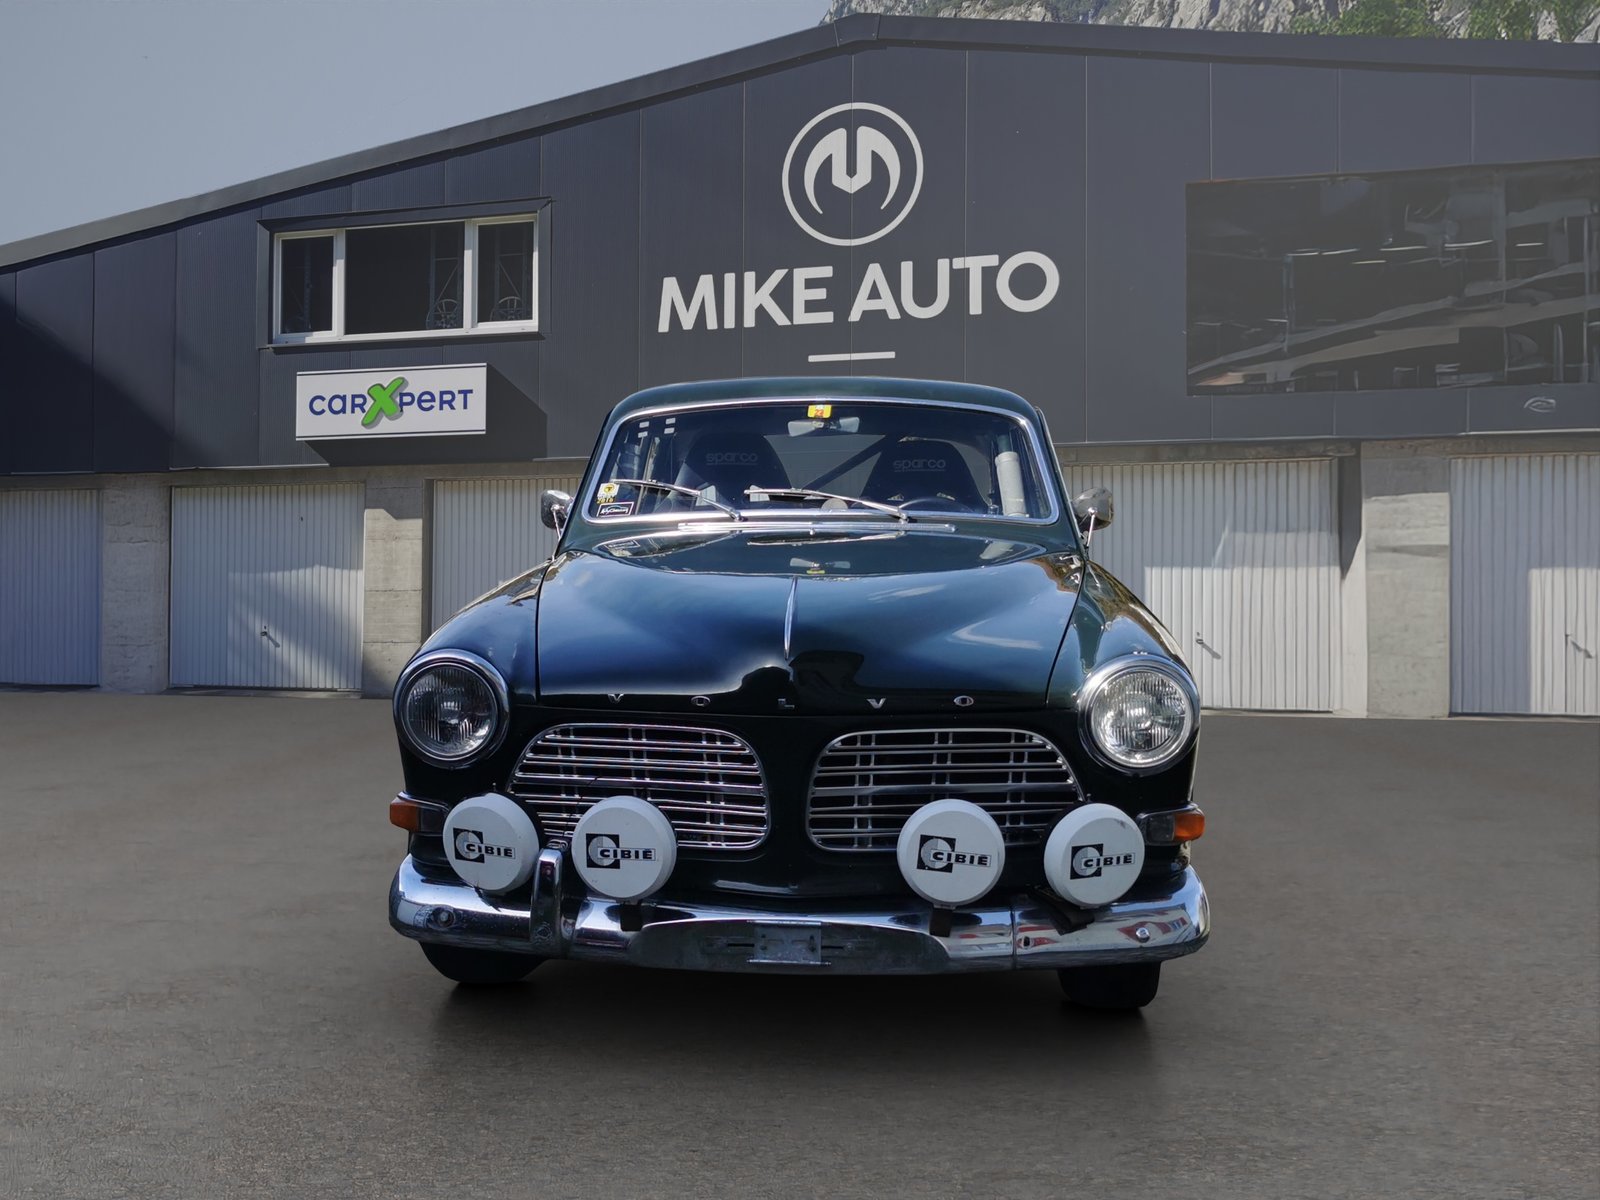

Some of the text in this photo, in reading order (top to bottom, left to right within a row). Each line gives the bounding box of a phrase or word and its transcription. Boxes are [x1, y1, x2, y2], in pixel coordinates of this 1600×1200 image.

[658, 251, 1060, 333] MIKE AUTO
[706, 452, 759, 465] sparco
[892, 459, 946, 472] sparco
[607, 693, 974, 709] VOLVO
